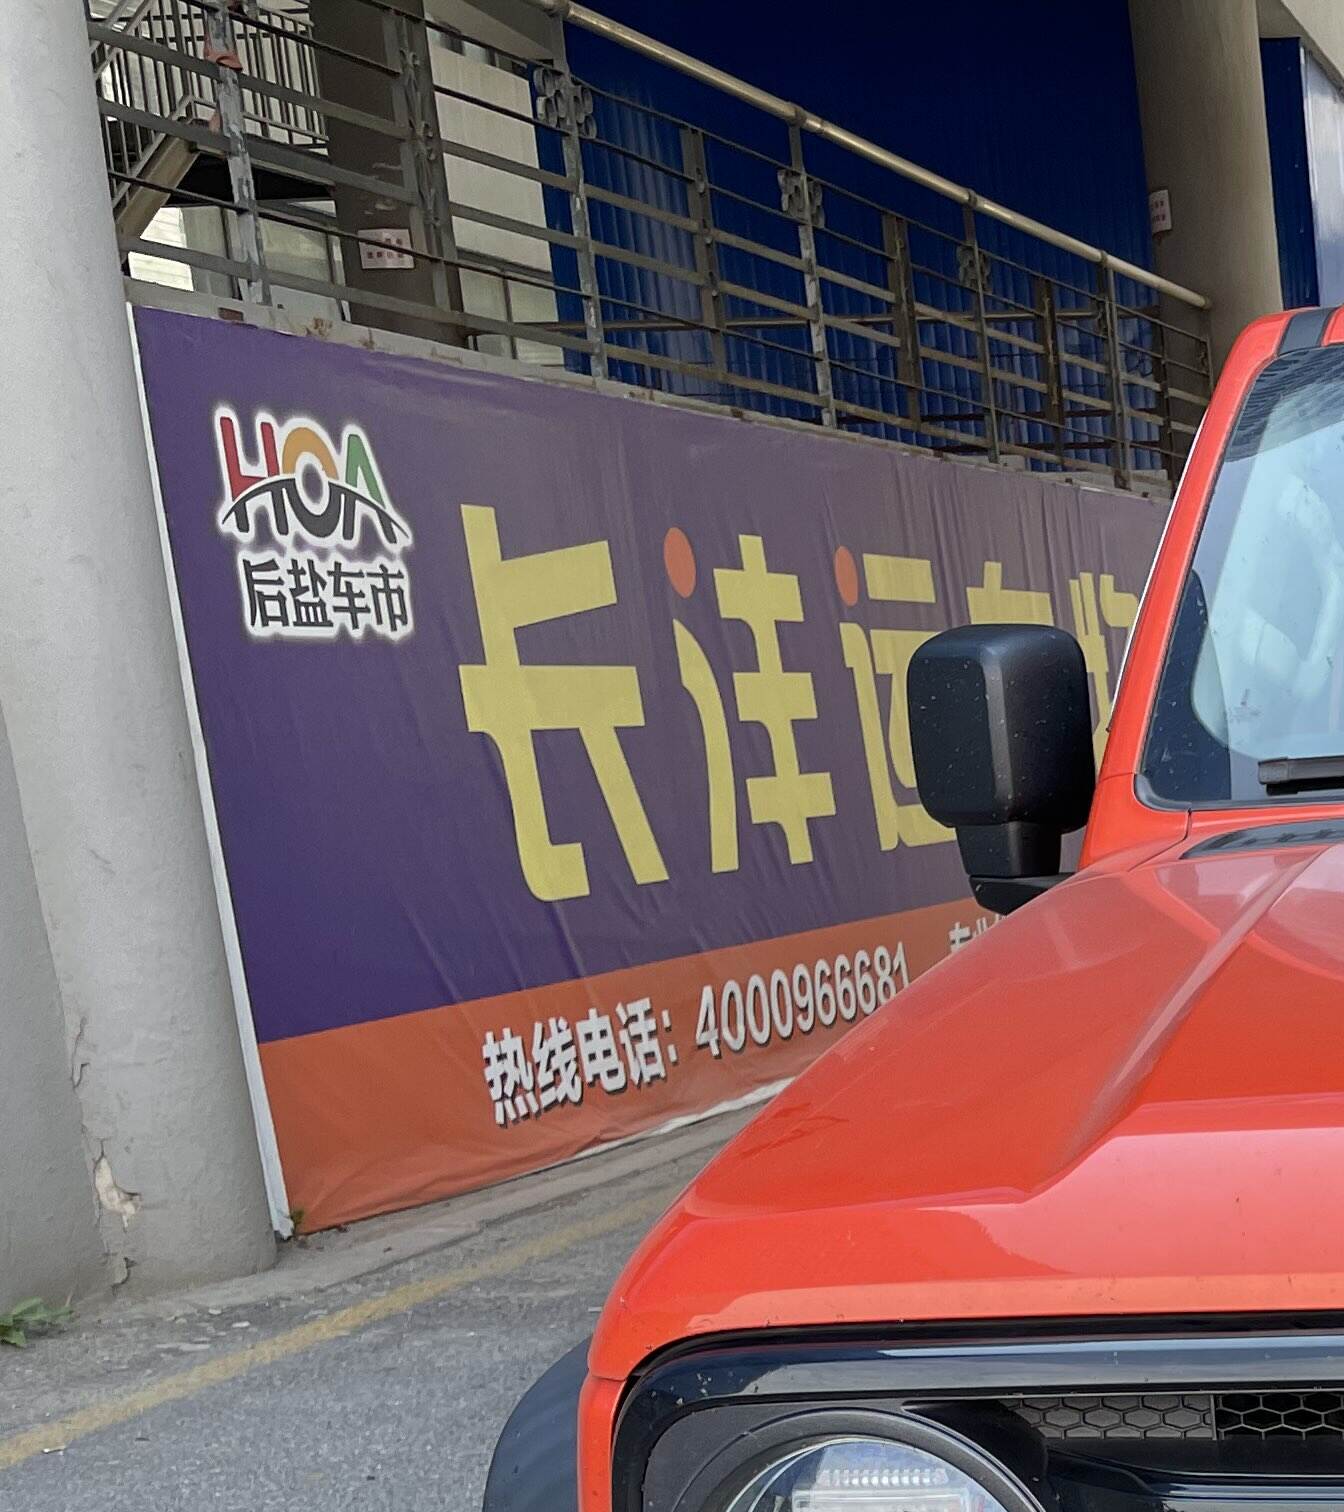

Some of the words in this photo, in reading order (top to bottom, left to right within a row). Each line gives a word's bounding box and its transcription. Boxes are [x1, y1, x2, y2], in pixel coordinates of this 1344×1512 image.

[220, 416, 409, 544] HOA
[242, 558, 408, 631] 后盐车市
[696, 941, 909, 1057] 4000966681
